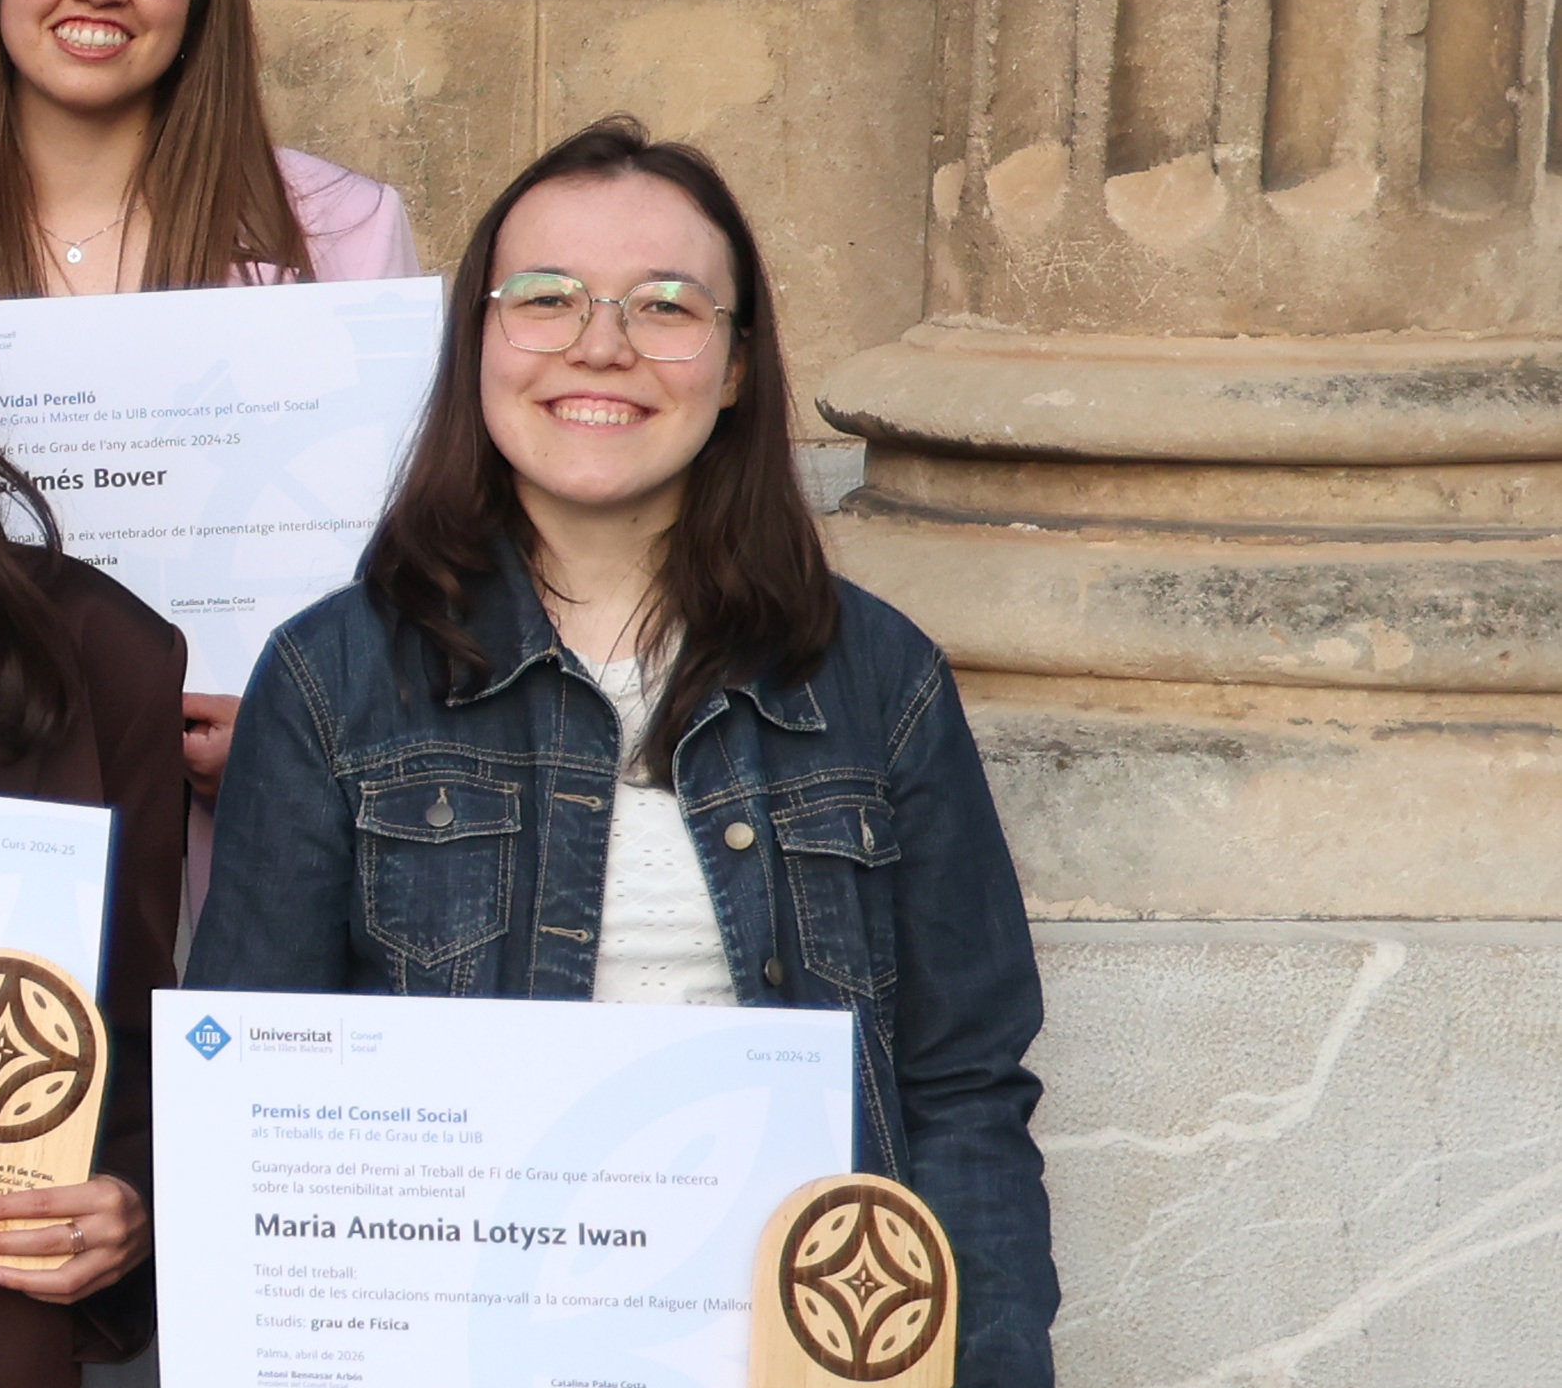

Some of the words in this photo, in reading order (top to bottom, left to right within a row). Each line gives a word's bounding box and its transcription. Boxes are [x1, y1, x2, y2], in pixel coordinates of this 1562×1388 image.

[43, 391, 96, 406] Perelló
[130, 435, 187, 450] acadèmic
[191, 432, 241, 447] 2024-25
[94, 468, 167, 488] Bover
[194, 1029, 221, 1046] UIB
[249, 1027, 332, 1043] Universitat
[254, 1213, 336, 1239] Maria
[347, 1215, 461, 1242] Antonia
[473, 1219, 567, 1251] Lotysz
[578, 1222, 647, 1248] Iwan
[255, 1313, 308, 1328] Estudis:
[310, 1318, 343, 1332] grau
[347, 1316, 365, 1330] de
[369, 1317, 410, 1331] Física
